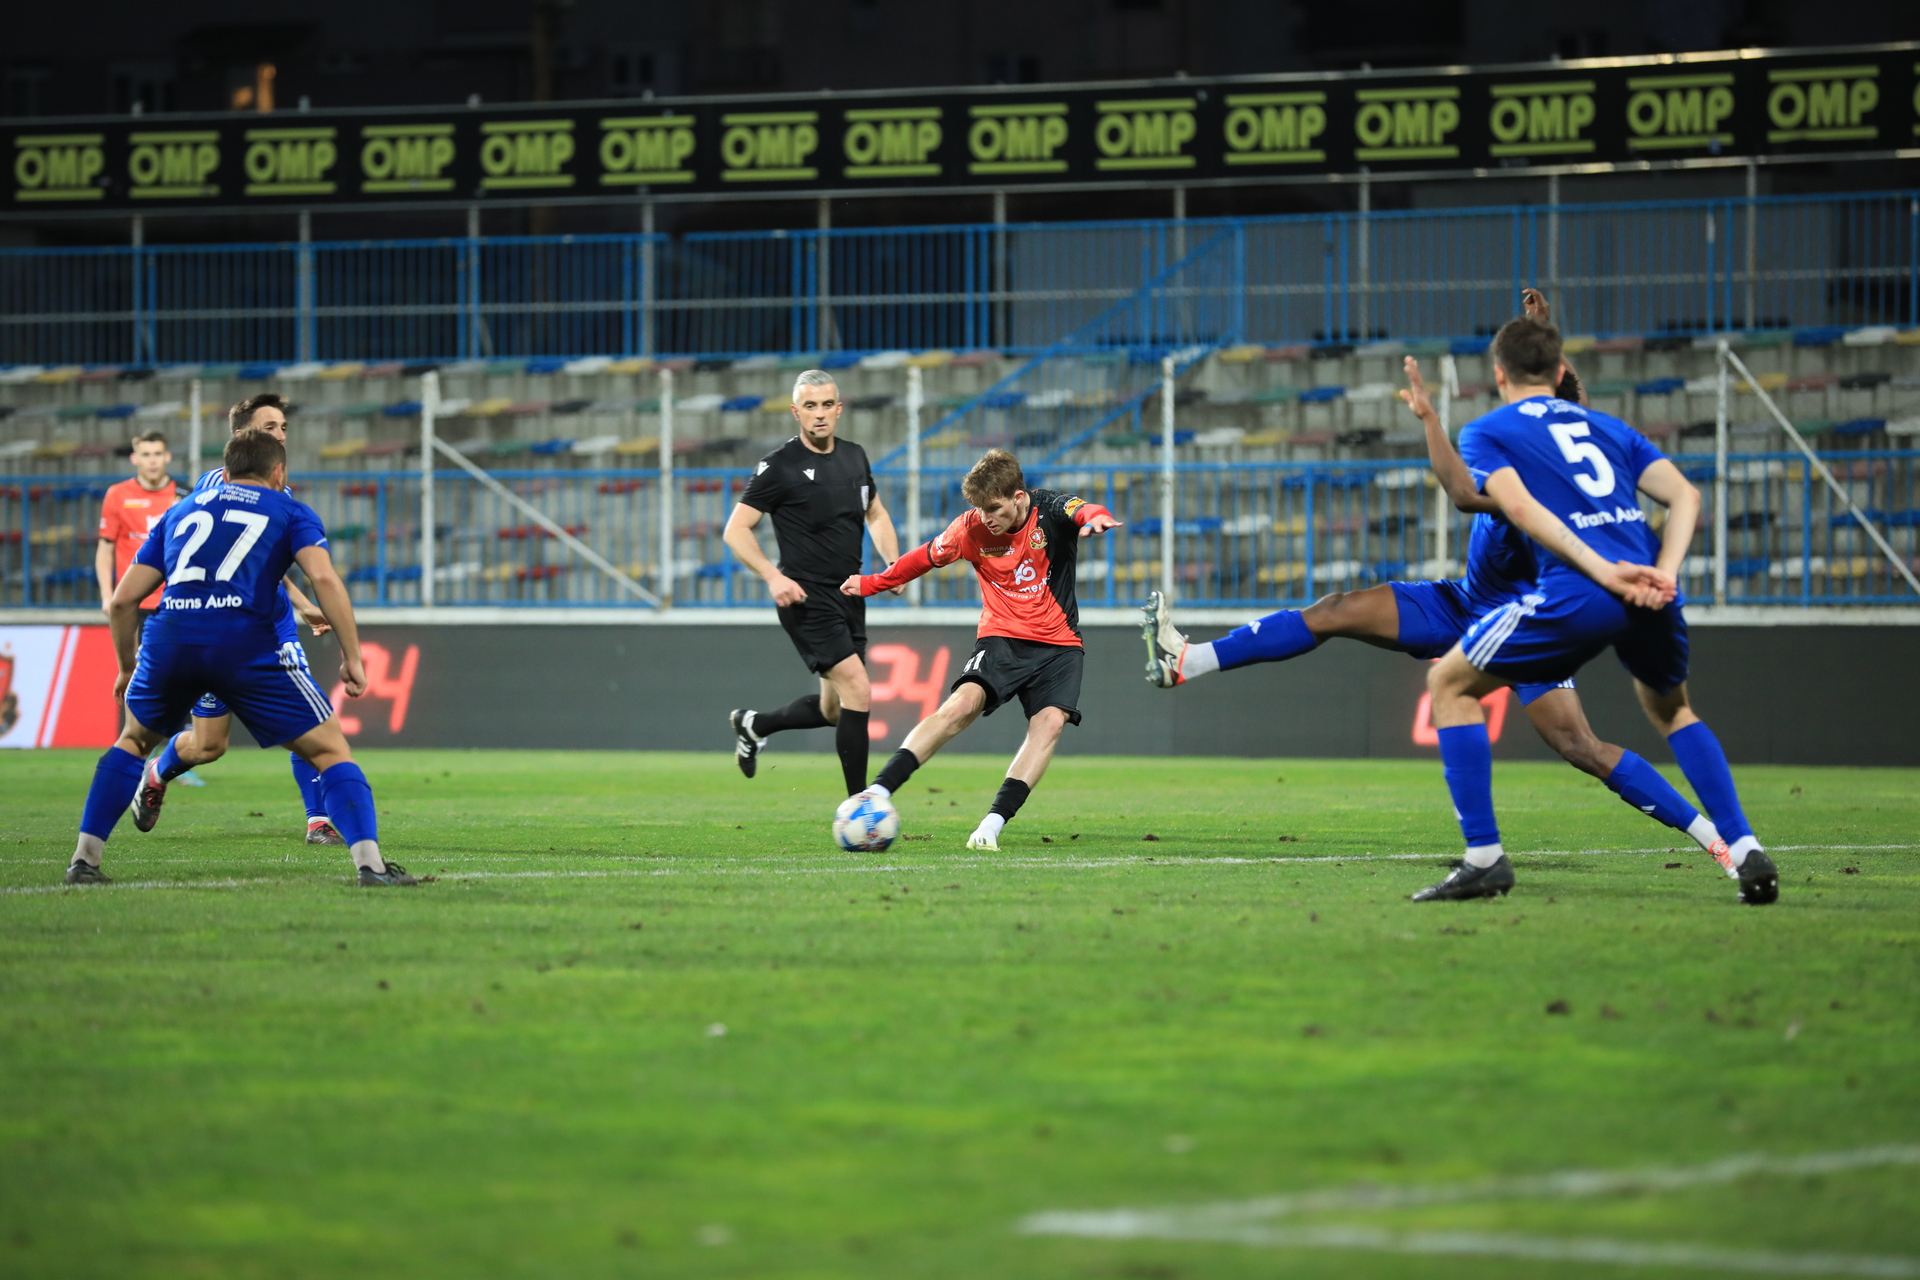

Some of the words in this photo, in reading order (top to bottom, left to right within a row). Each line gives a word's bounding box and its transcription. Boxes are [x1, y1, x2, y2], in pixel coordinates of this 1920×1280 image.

[1356, 100, 1460, 146] OMP
[1490, 95, 1595, 142] OMP
[1628, 88, 1734, 135] OMP
[1769, 81, 1878, 127] OMP
[601, 128, 695, 171] OMP
[722, 124, 817, 167] OMP
[845, 120, 941, 164] OMP
[970, 116, 1067, 160] OMP
[1096, 112, 1197, 156] OMP
[1225, 105, 1326, 150] OMP
[18, 147, 102, 187] OMP
[131, 144, 218, 184] OMP
[246, 140, 335, 181] OMP
[362, 137, 454, 178] OMP
[482, 133, 574, 175] OMP
[1547, 421, 1615, 497] 5
[1569, 511, 1615, 529] Tran
[168, 509, 269, 586] 27
[163, 596, 202, 610] Trans
[205, 594, 242, 609] Auto
